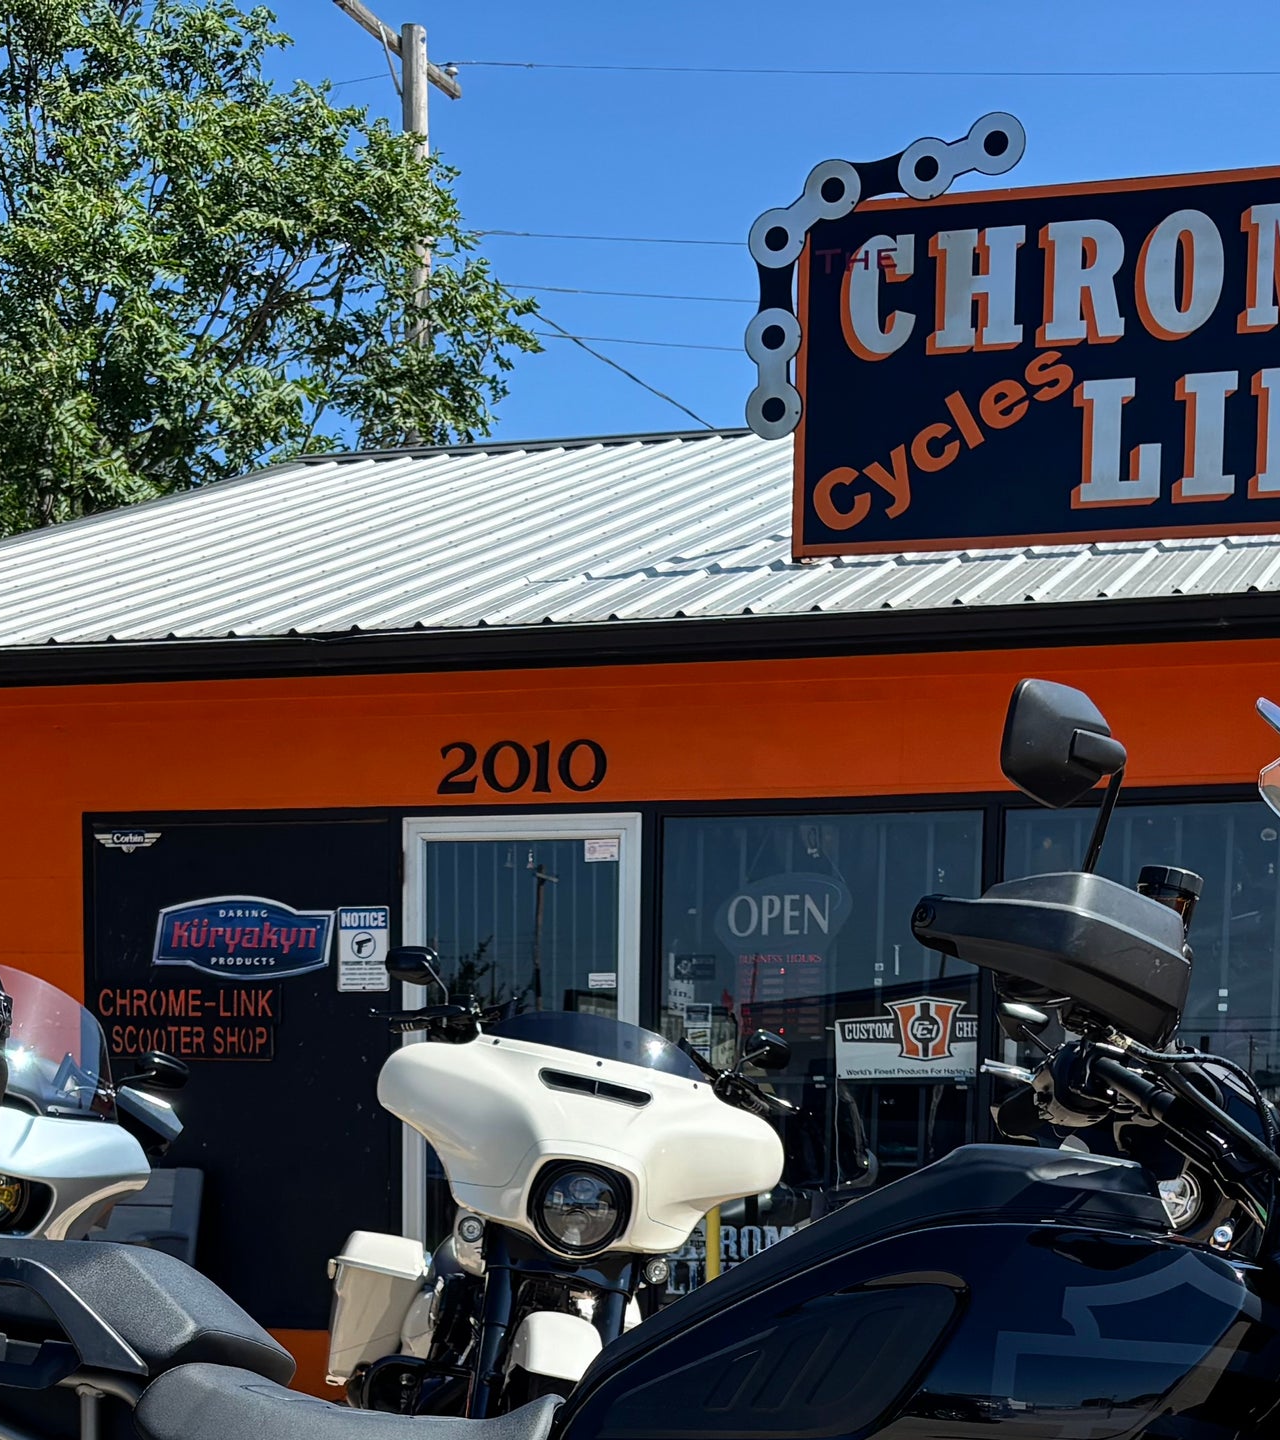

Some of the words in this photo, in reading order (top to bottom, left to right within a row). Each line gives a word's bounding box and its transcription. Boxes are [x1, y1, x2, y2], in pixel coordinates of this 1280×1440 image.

[813, 350, 1075, 532] Cycles
[437, 739, 607, 795] 2010
[113, 833, 144, 843] Corbin
[219, 909, 269, 918] DARING
[341, 912, 387, 927] NOTICE
[727, 893, 829, 938] OPEN
[171, 918, 317, 953] Küryakyn
[210, 957, 276, 966] PRODUCTS
[844, 1023, 895, 1039] CUSTOM
[111, 1026, 206, 1055] SCOOTER
[213, 1027, 267, 1054] SHOP
[897, 1067, 928, 1075] Products
[930, 1066, 942, 1074] For
